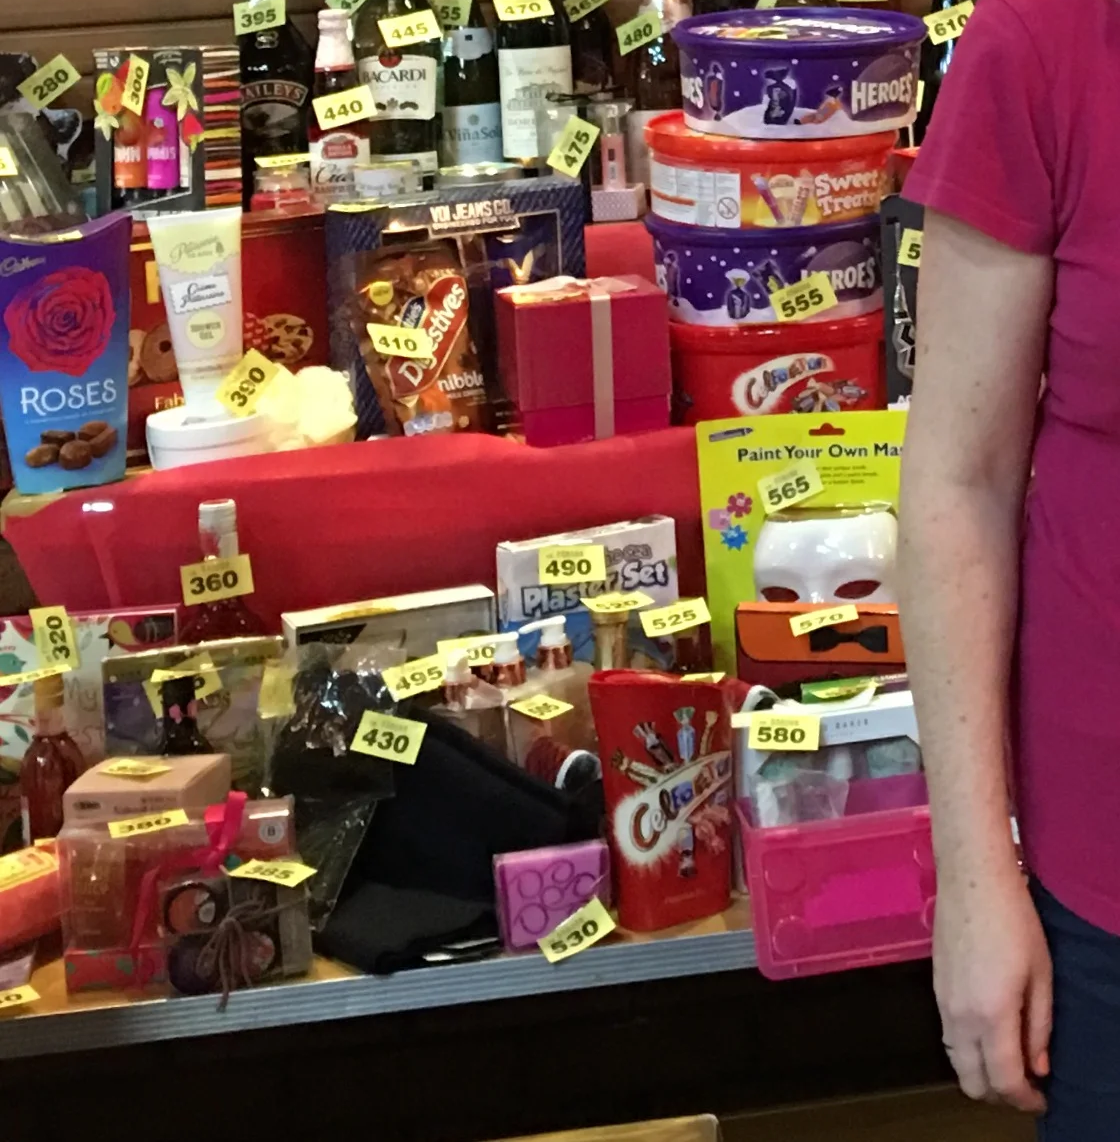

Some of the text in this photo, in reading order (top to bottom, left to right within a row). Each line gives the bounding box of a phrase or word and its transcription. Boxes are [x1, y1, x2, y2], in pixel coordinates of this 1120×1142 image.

[240, 8, 277, 30] 395
[440, 3, 462, 20] 55
[503, 1, 542, 15] 470
[390, 23, 429, 41] 445
[622, 22, 654, 48] 480
[934, 13, 968, 38] 610
[31, 67, 70, 102] 280
[130, 66, 145, 106] 300
[362, 69, 428, 84] BACARDI
[851, 73, 913, 115] HEROES
[323, 100, 364, 122] 440
[564, 129, 591, 171] 475
[814, 169, 879, 196] Sweet
[817, 191, 877, 216] Treats
[780, 288, 824, 318] 555
[378, 335, 418, 352] 410
[20, 377, 118, 417] ROSES
[230, 366, 267, 408] 390
[737, 445, 783, 463] Paint
[784, 444, 823, 460] Your
[828, 443, 869, 459] Own
[767, 475, 811, 506] 565
[544, 558, 593, 577] 490
[621, 559, 669, 592] Set
[189, 569, 239, 596] 360
[651, 609, 697, 630] 525
[799, 612, 844, 631] 570
[46, 615, 71, 660] 320
[395, 666, 444, 693] 495
[362, 728, 410, 754] 430
[756, 726, 806, 744] 580
[549, 919, 600, 957] 530
